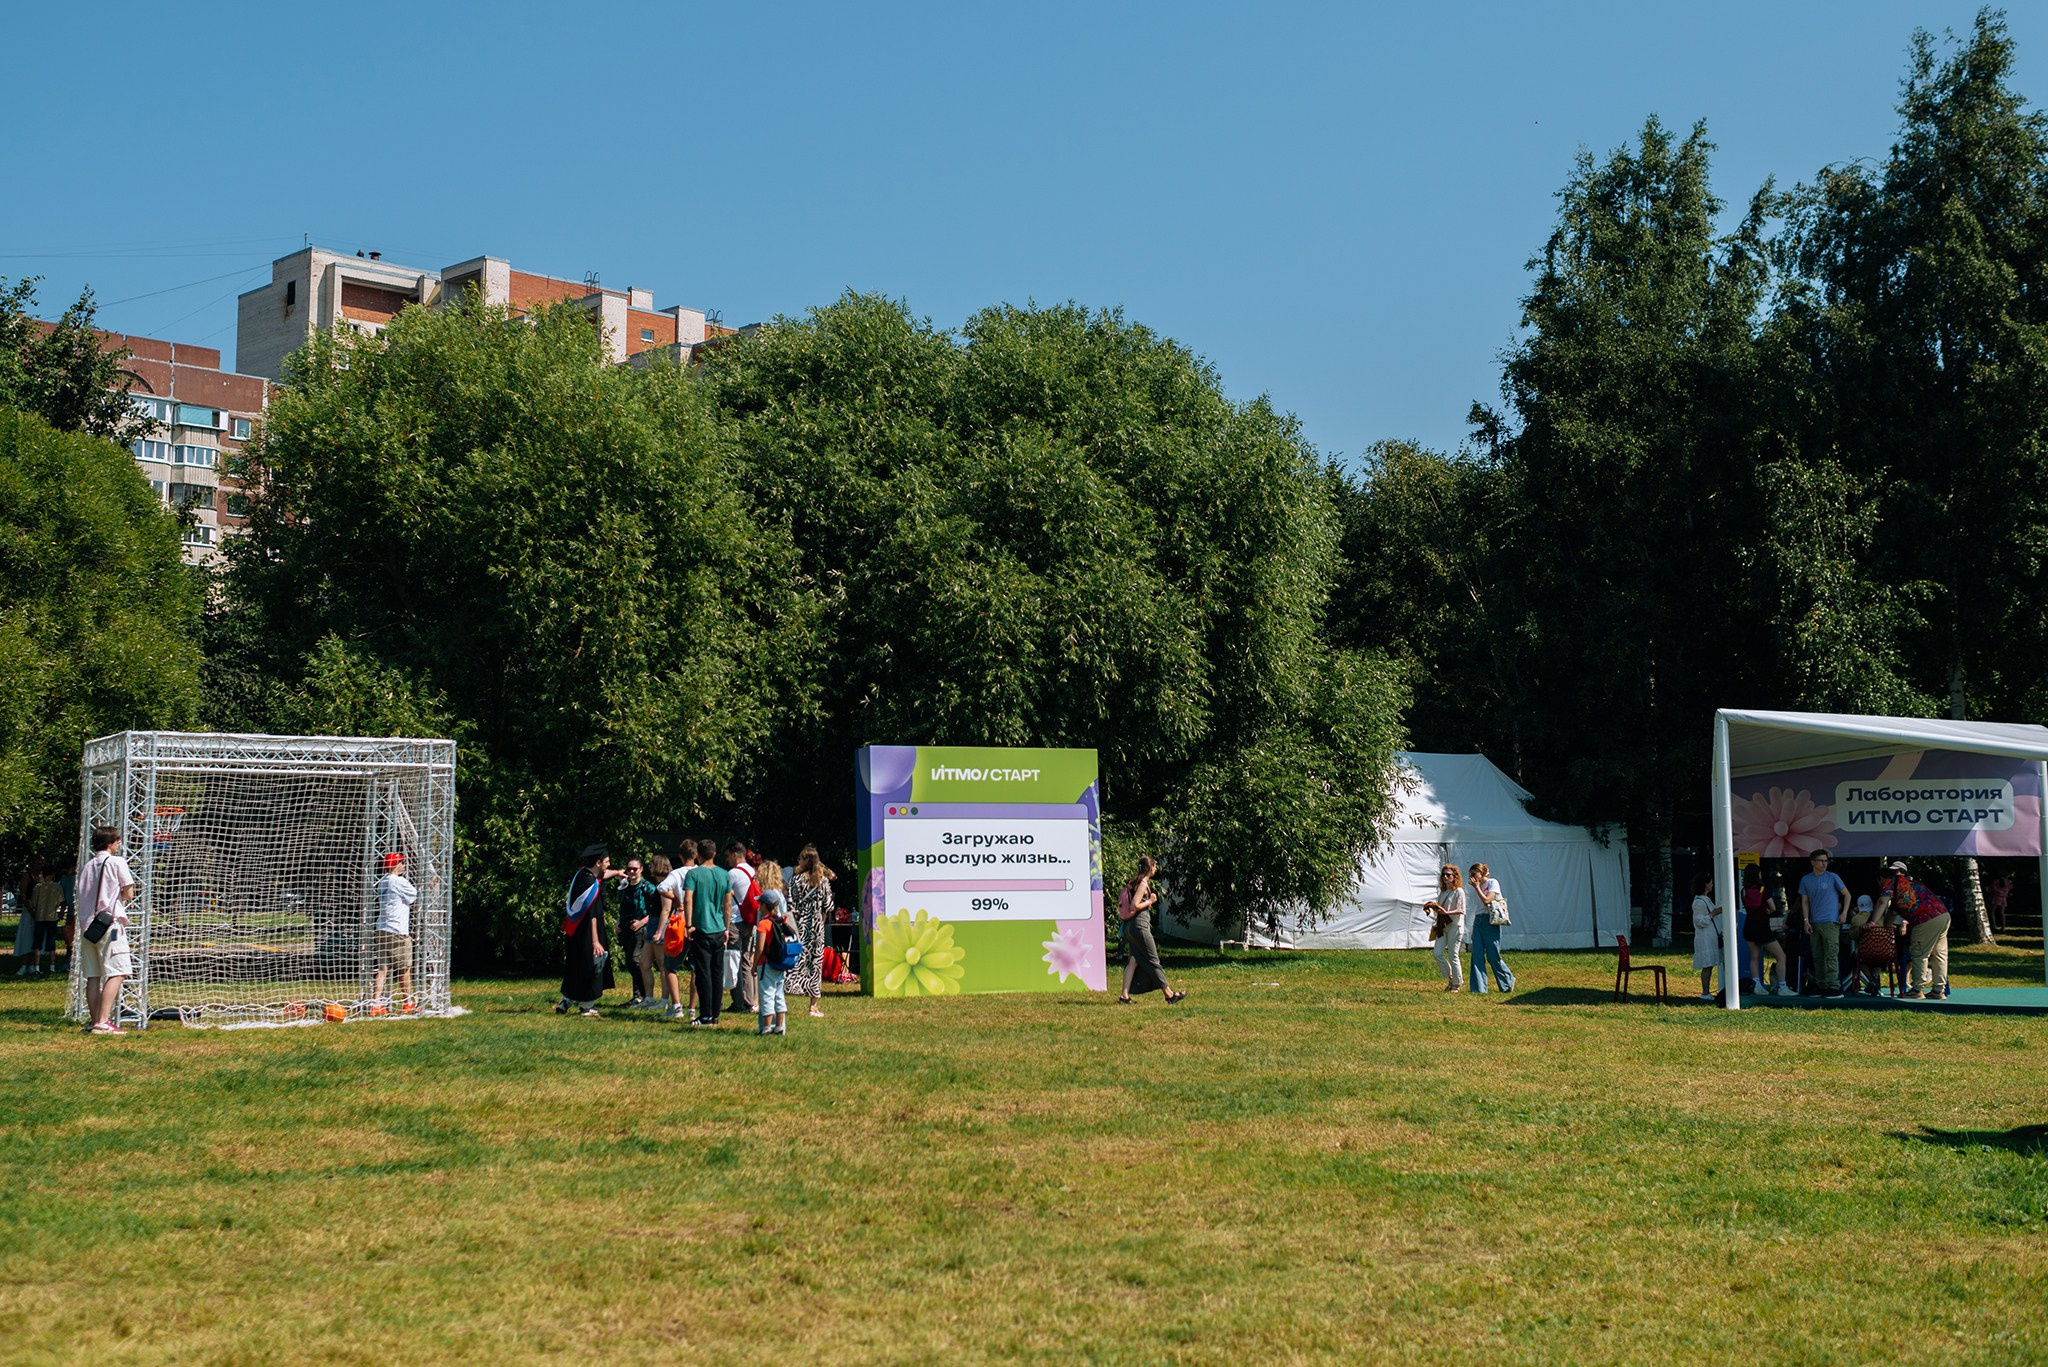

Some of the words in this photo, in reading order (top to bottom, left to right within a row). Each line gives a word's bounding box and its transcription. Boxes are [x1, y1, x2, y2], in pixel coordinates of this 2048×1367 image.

[1846, 787, 2003, 803] Лаборатория
[1849, 809, 1921, 825] ИТМО
[1926, 809, 2004, 824] СТАРТ
[942, 832, 1034, 848] Загружаю
[905, 854, 997, 867] взрослую
[1001, 853, 1071, 864] жизнь...
[971, 898, 1009, 911] 99%
